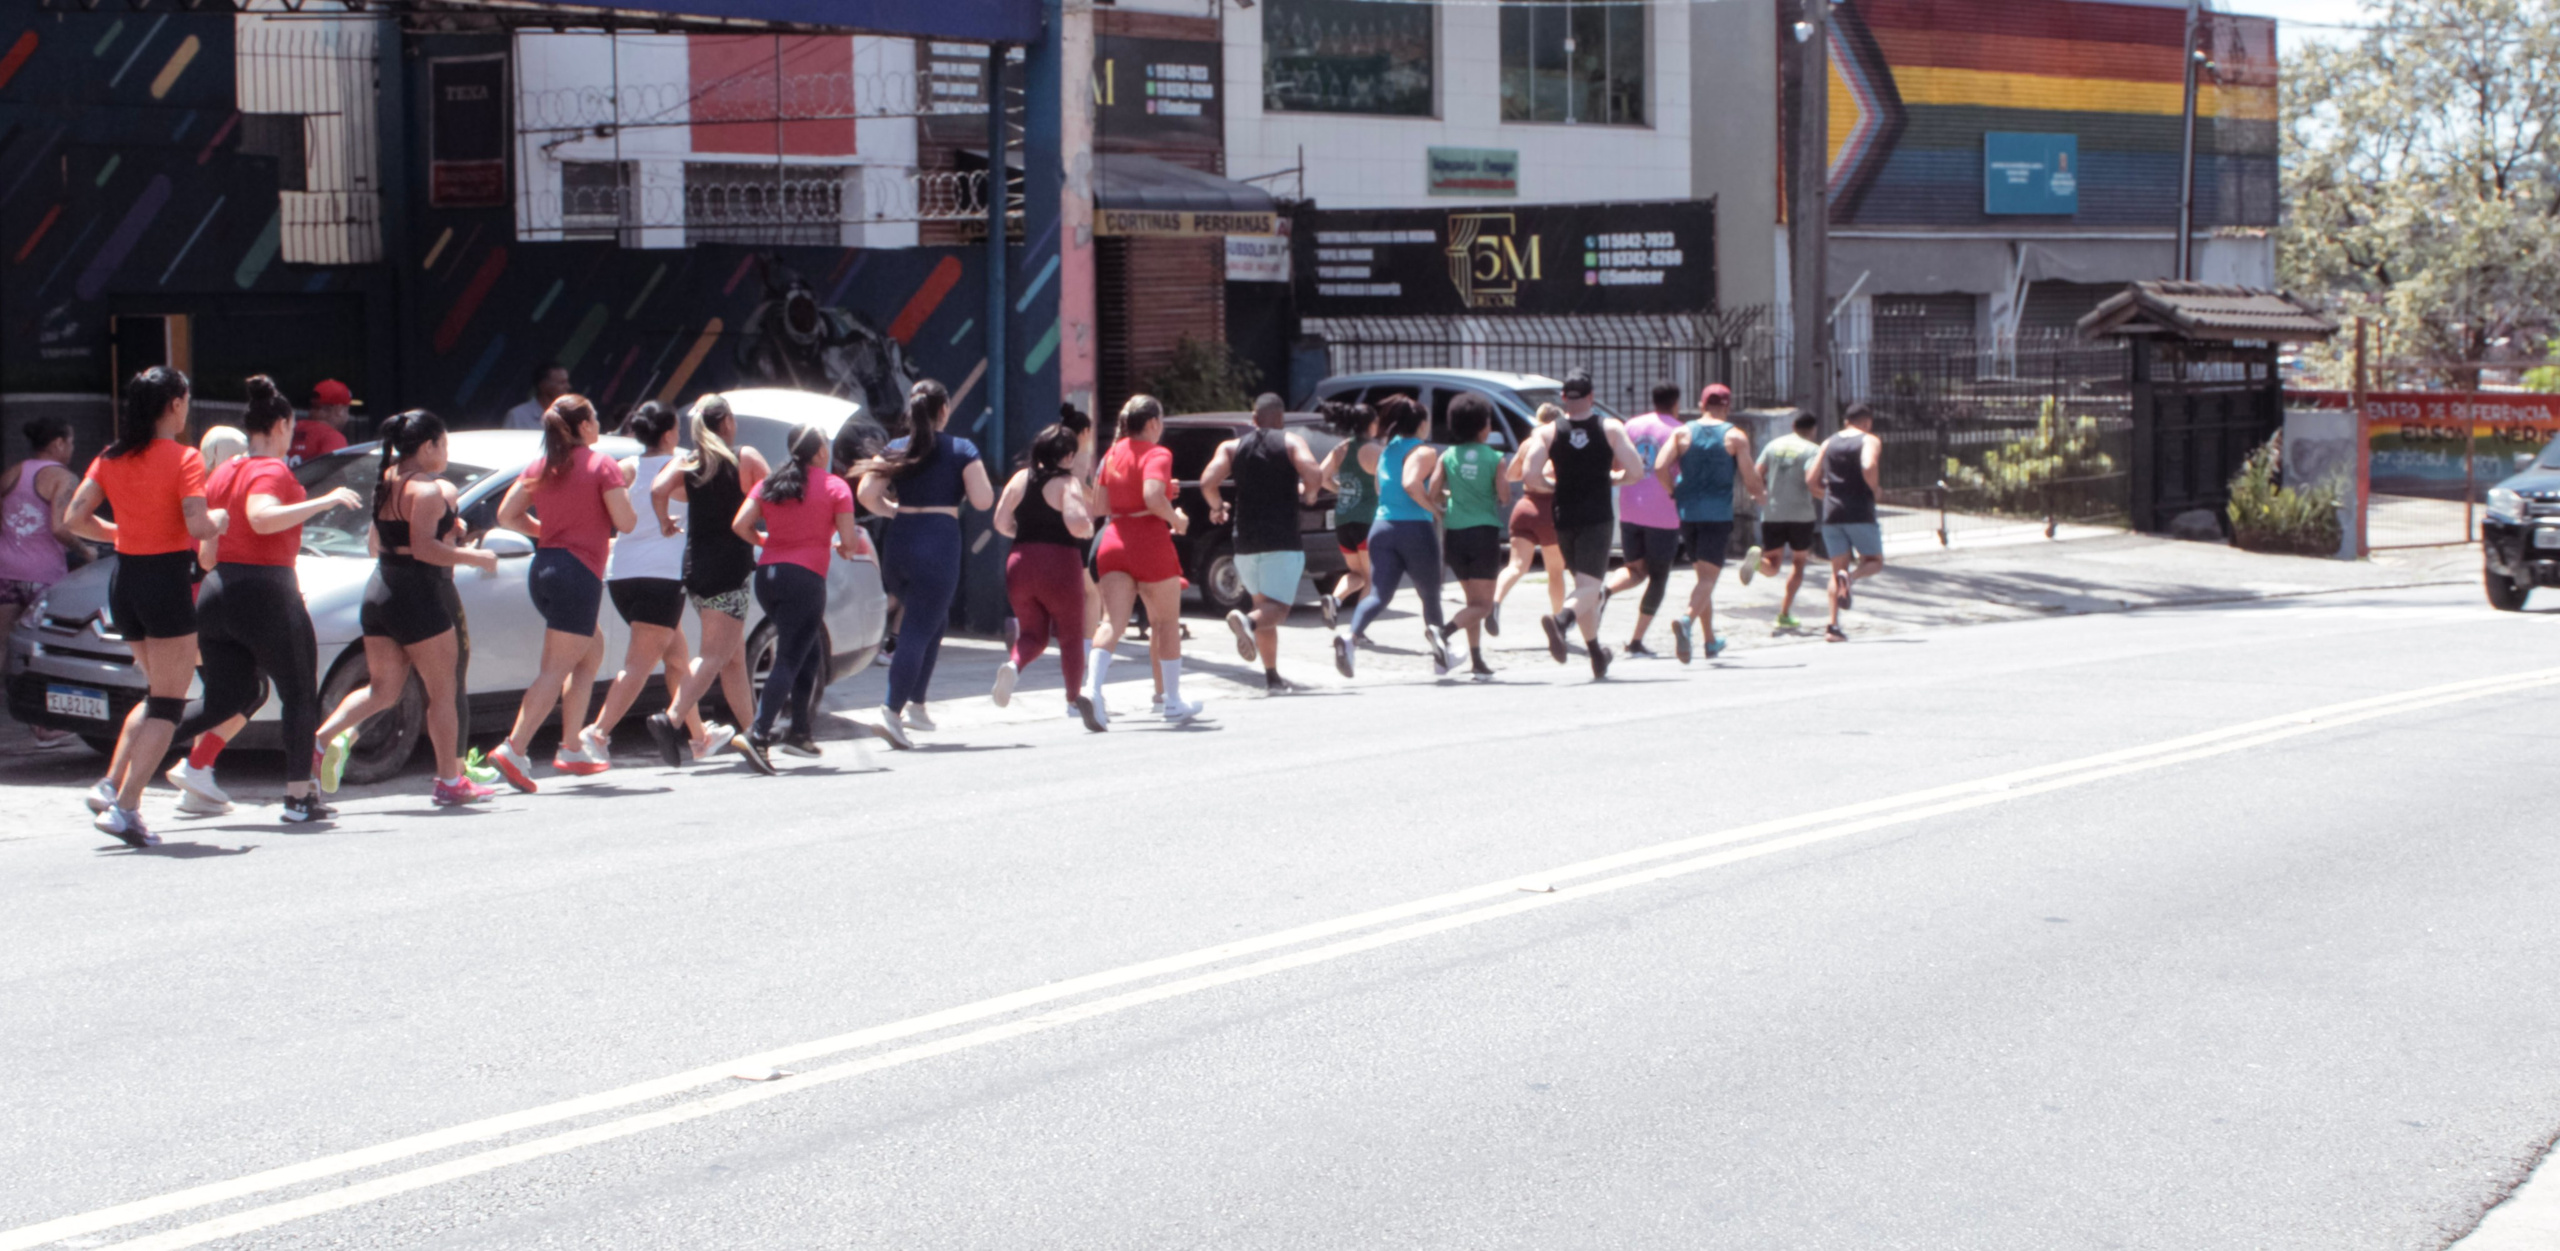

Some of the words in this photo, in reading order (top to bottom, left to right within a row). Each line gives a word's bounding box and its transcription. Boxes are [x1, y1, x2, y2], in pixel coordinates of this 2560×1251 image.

[1105, 212, 1181, 232] CORTINAS
[1193, 213, 1270, 233] PERSIANAS
[1474, 234, 1542, 281] 5M
[2366, 401, 2421, 420] ENTRO
[2426, 402, 2446, 420] DE
